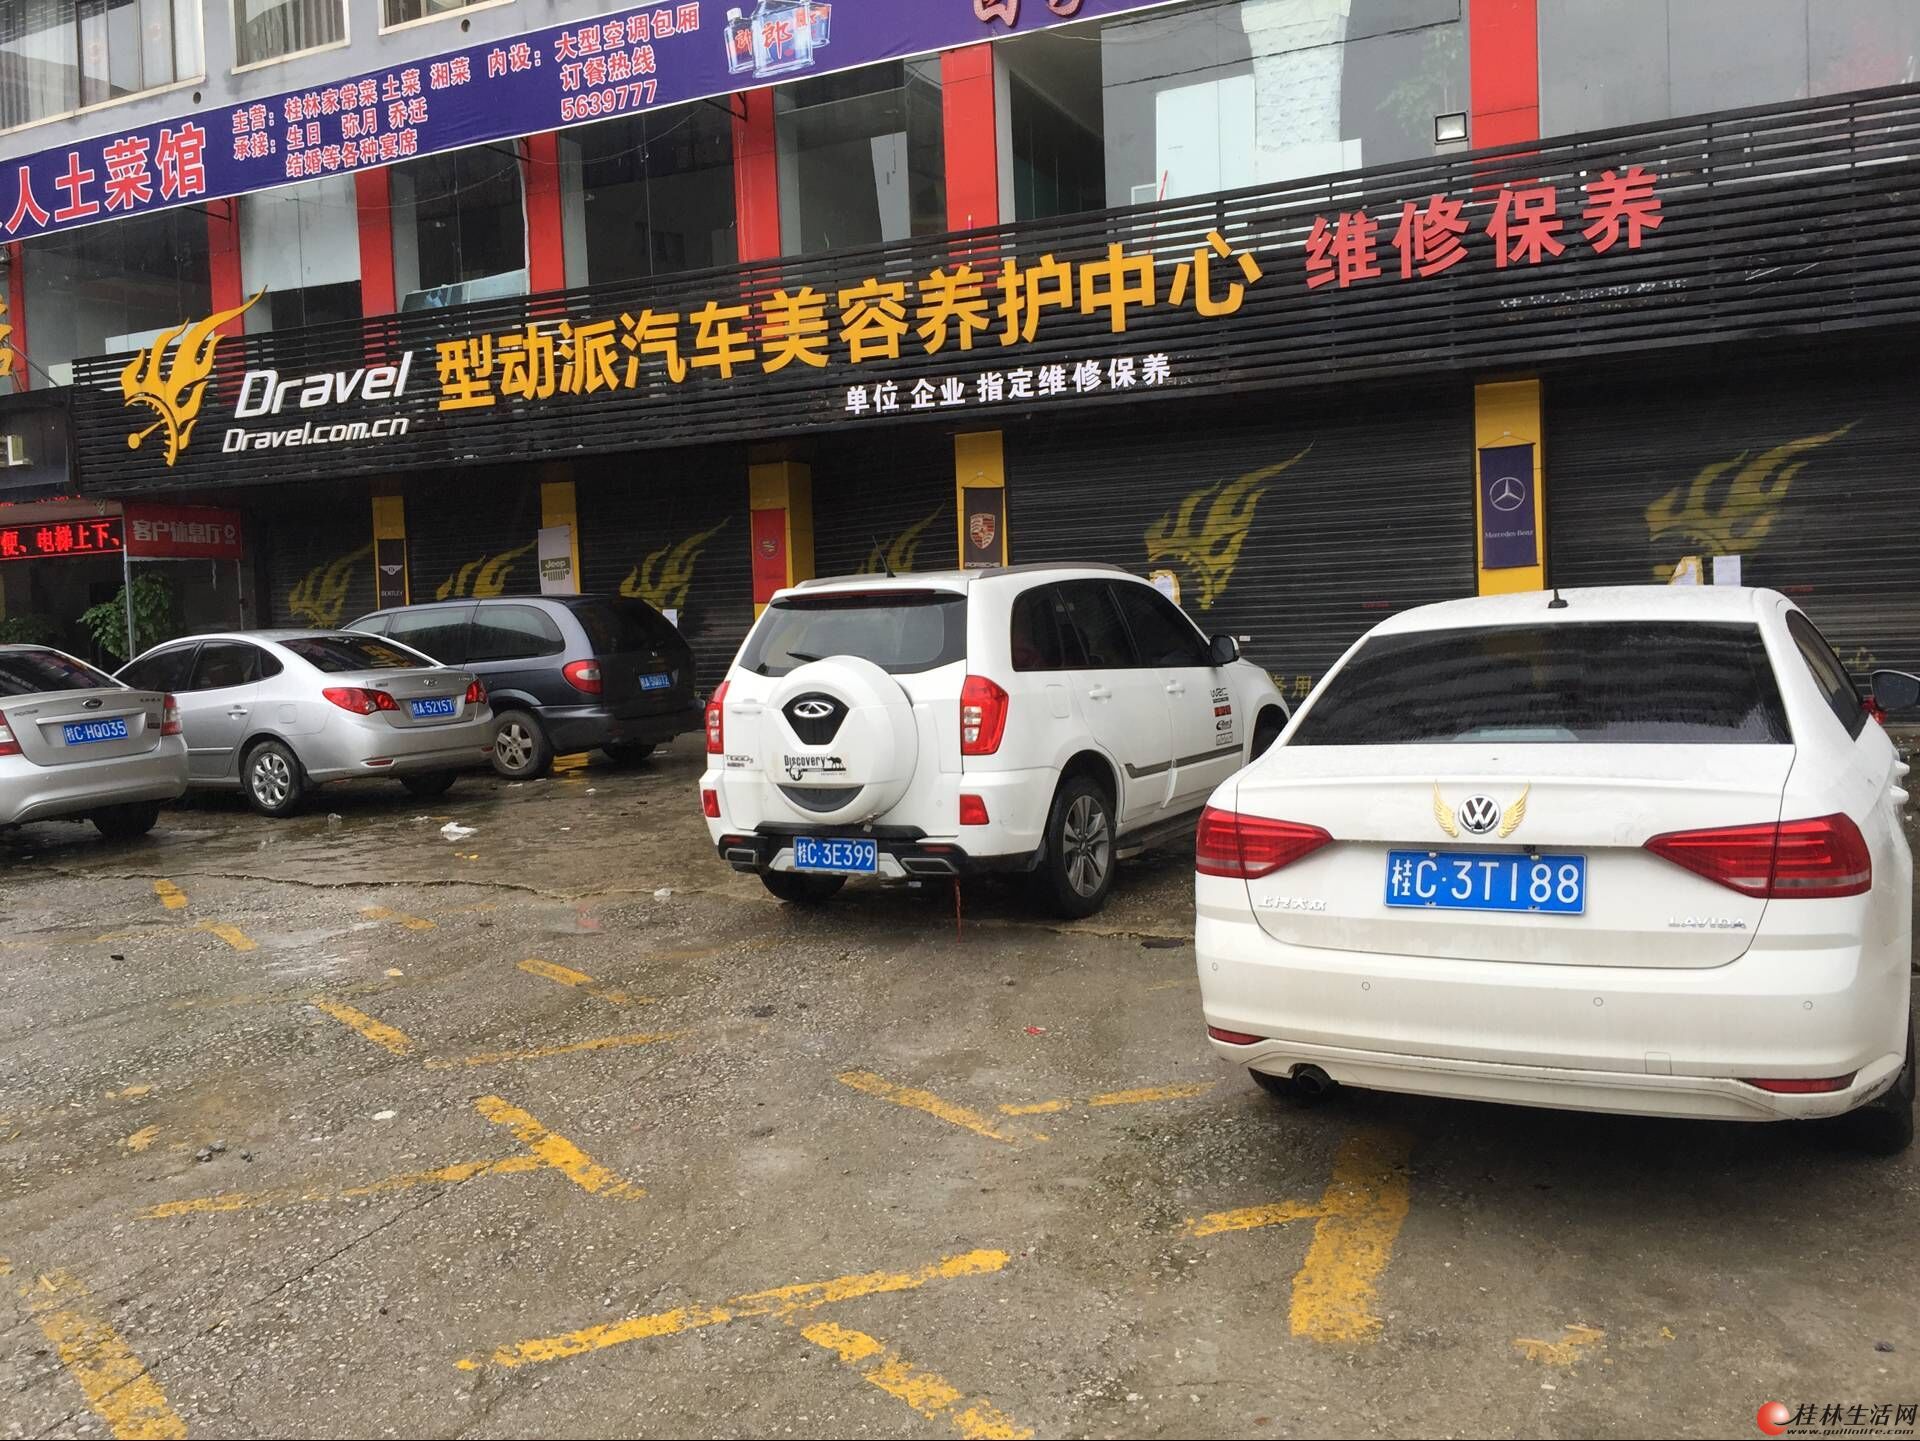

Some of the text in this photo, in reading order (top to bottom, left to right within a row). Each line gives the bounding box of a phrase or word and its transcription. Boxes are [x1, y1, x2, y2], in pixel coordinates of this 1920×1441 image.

[284, 79, 378, 123] 桂林家常菜
[382, 68, 421, 101] 土菜
[430, 56, 471, 90] 湘菜
[555, 2, 700, 63] 大型空调包厢
[560, 45, 656, 92] 订餐热线
[286, 121, 321, 150] 生日
[388, 97, 428, 130] 乔迁
[561, 79, 658, 122] 5639777
[5, 121, 207, 235] 人土菜馆
[286, 128, 418, 178] 结婚等各种宴席
[1304, 165, 1665, 290] 维修保养
[436, 230, 1263, 411] 型动派汽车美容养护中心
[234, 350, 414, 419] Dravel
[845, 382, 900, 415] 单位
[910, 375, 966, 410] 企业
[976, 352, 1171, 404] 指定维修保养
[222, 416, 410, 453] Dravel.com.cn
[784, 754, 826, 768] Discovery
[797, 839, 875, 868] 桂C·3E399
[1392, 859, 1580, 904] 桂C·3T188
